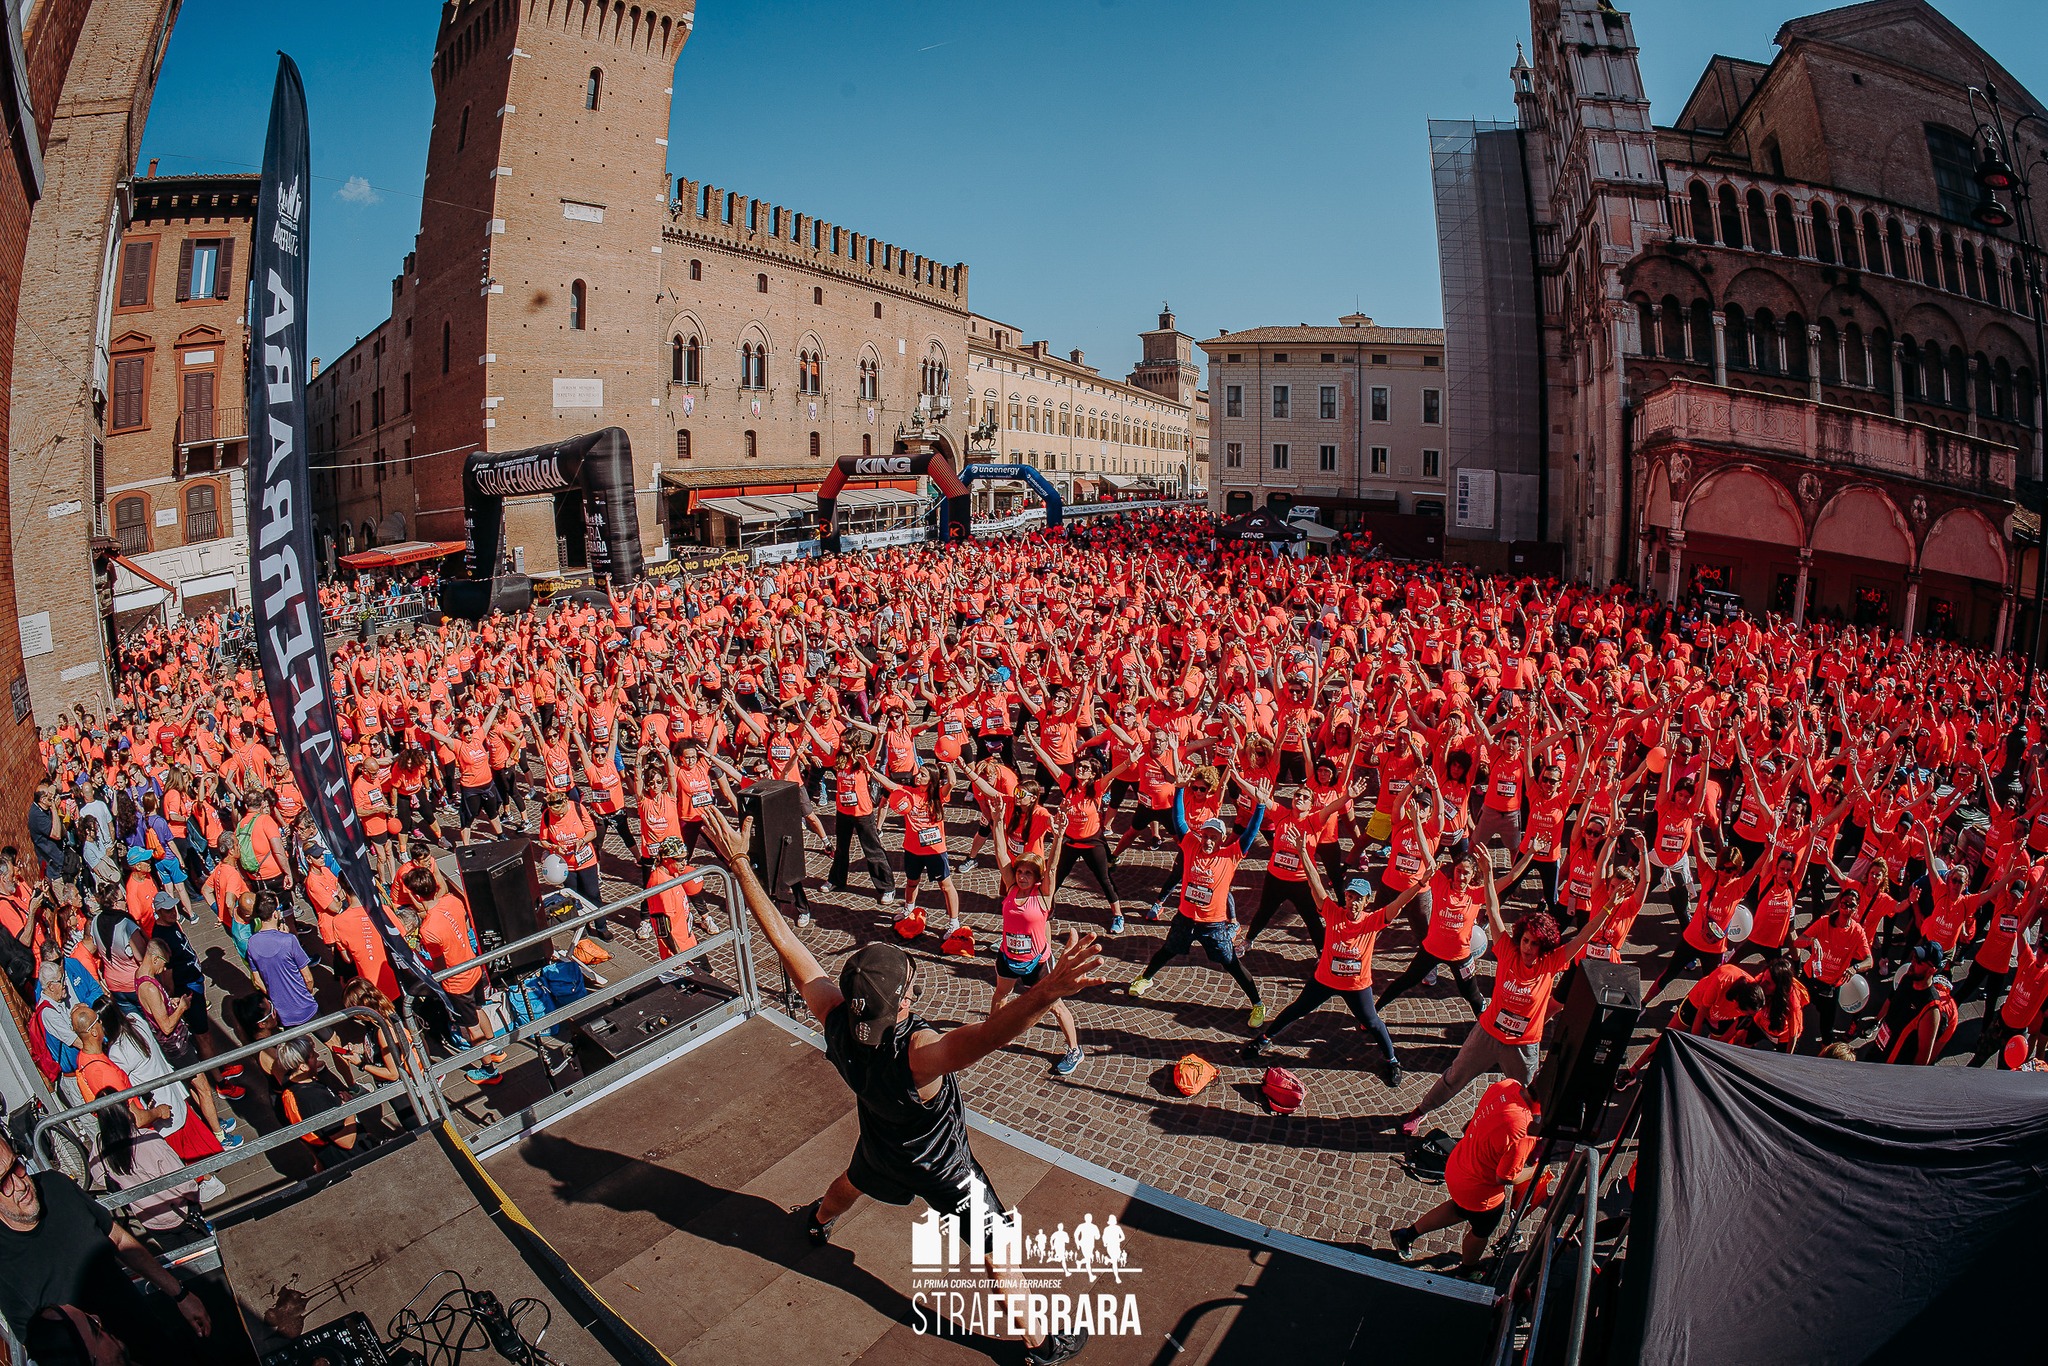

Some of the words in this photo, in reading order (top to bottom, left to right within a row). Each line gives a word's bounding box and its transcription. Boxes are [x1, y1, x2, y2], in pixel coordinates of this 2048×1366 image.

[855, 457, 912, 474] KING
[979, 466, 1020, 476] unoenergy
[476, 456, 568, 496] STRAFERRARA
[648, 561, 699, 577] RADIOBNO
[533, 578, 582, 593] ADIOBRUNO
[1191, 889, 1206, 900] 1345
[1337, 963, 1354, 972] 1344
[1502, 1016, 1521, 1029] 3316
